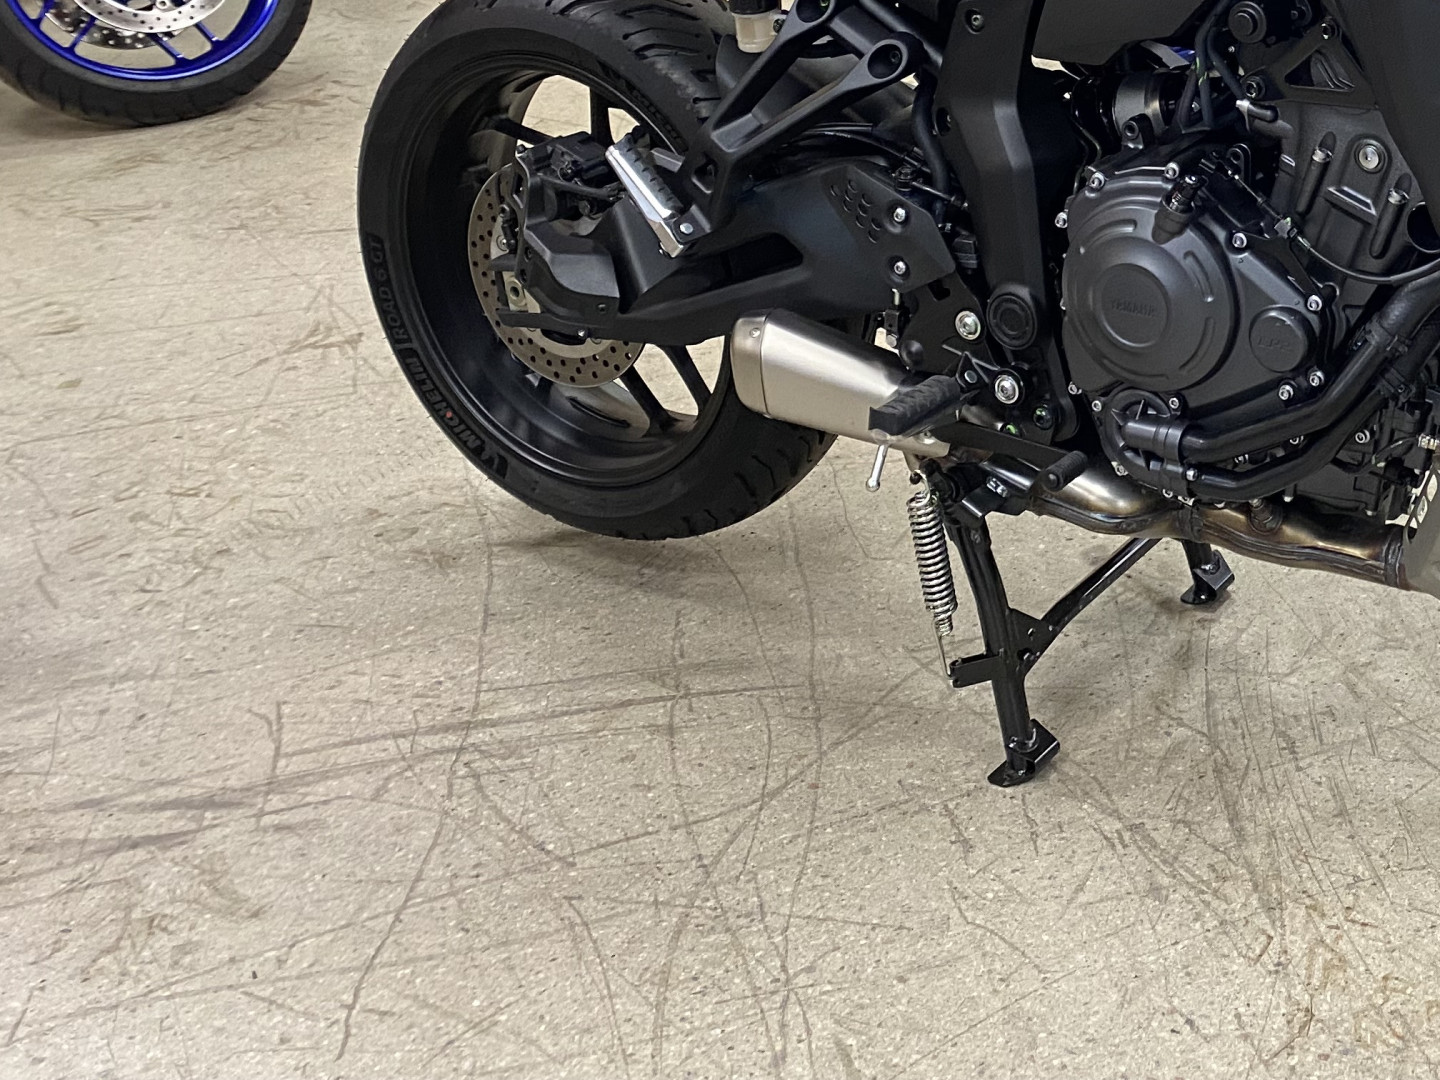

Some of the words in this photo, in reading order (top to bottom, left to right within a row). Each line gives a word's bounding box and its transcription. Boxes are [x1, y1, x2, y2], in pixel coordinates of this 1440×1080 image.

[368, 238, 384, 264] GT
[379, 285, 409, 343] ROAD
[404, 356, 482, 450] MICHELIN
